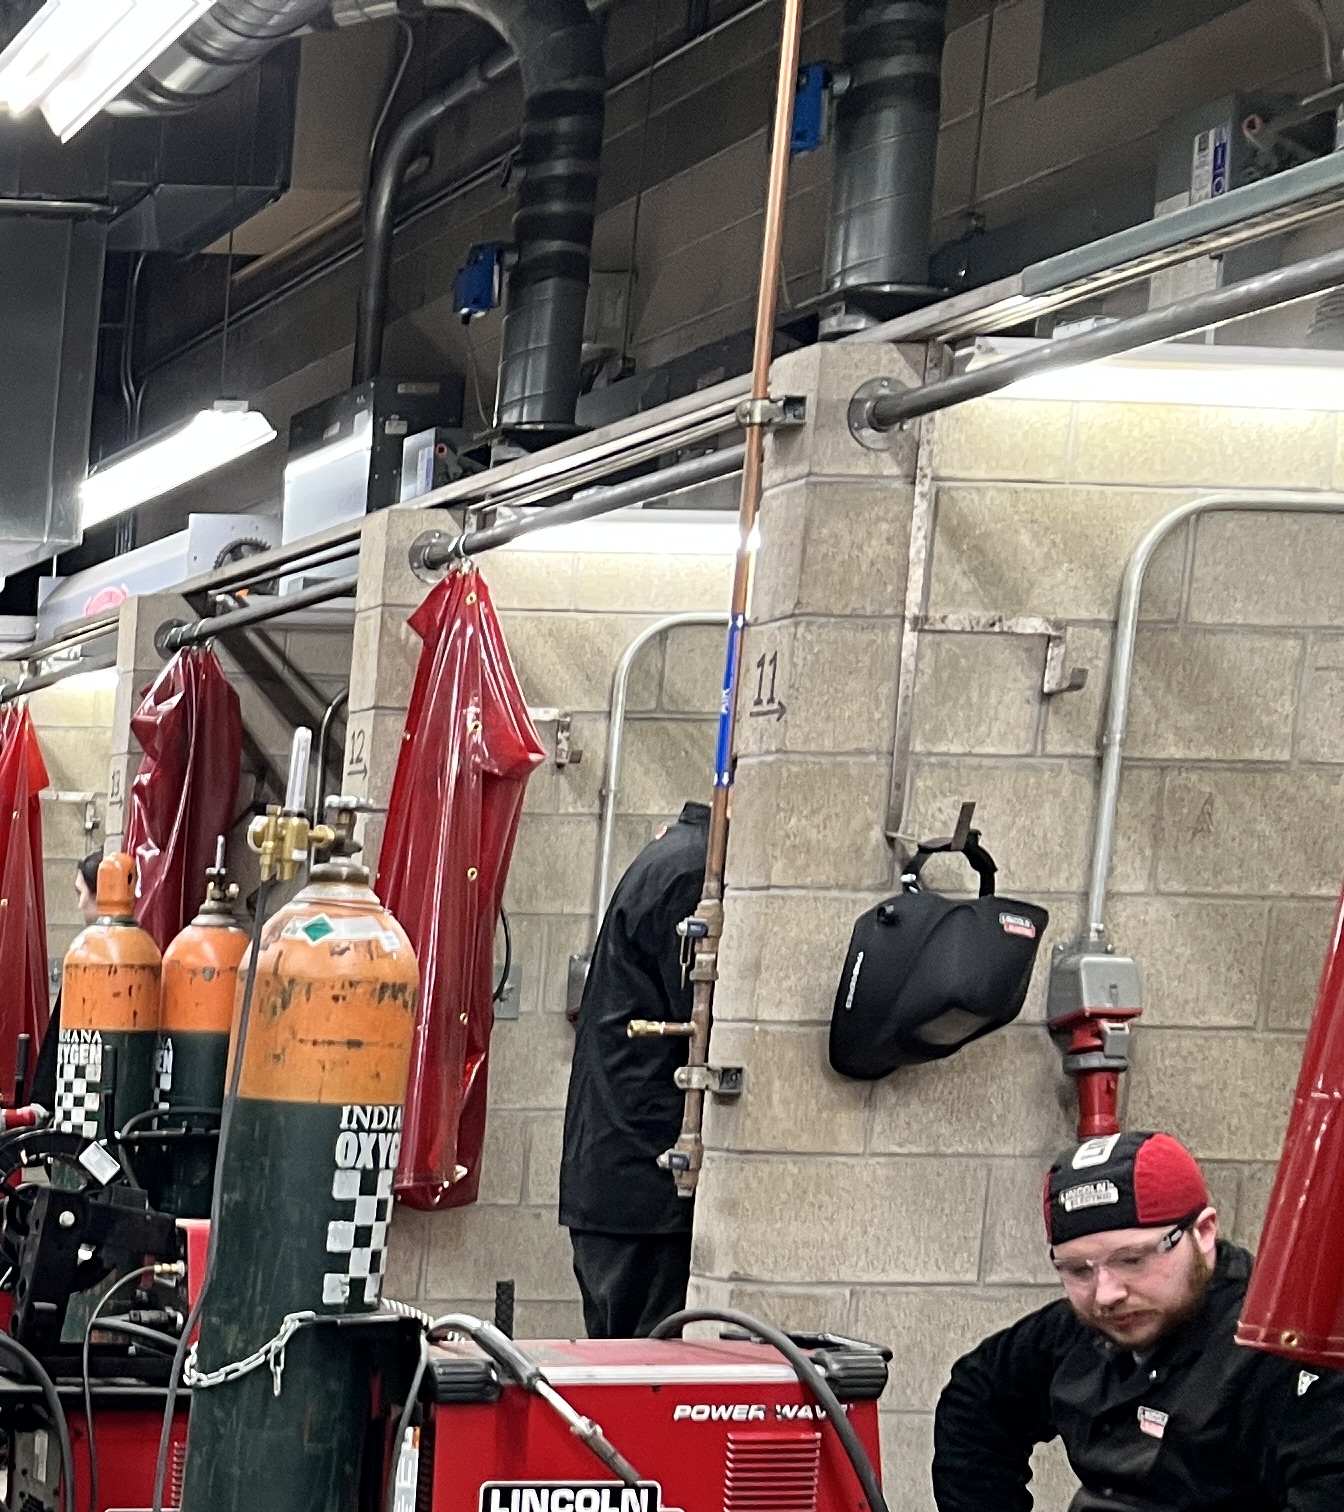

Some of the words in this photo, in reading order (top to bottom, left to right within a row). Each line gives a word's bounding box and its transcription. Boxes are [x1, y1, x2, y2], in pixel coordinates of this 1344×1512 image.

[753, 650, 778, 706] 11
[349, 729, 366, 766] 12
[673, 1404, 767, 1422] POWER
